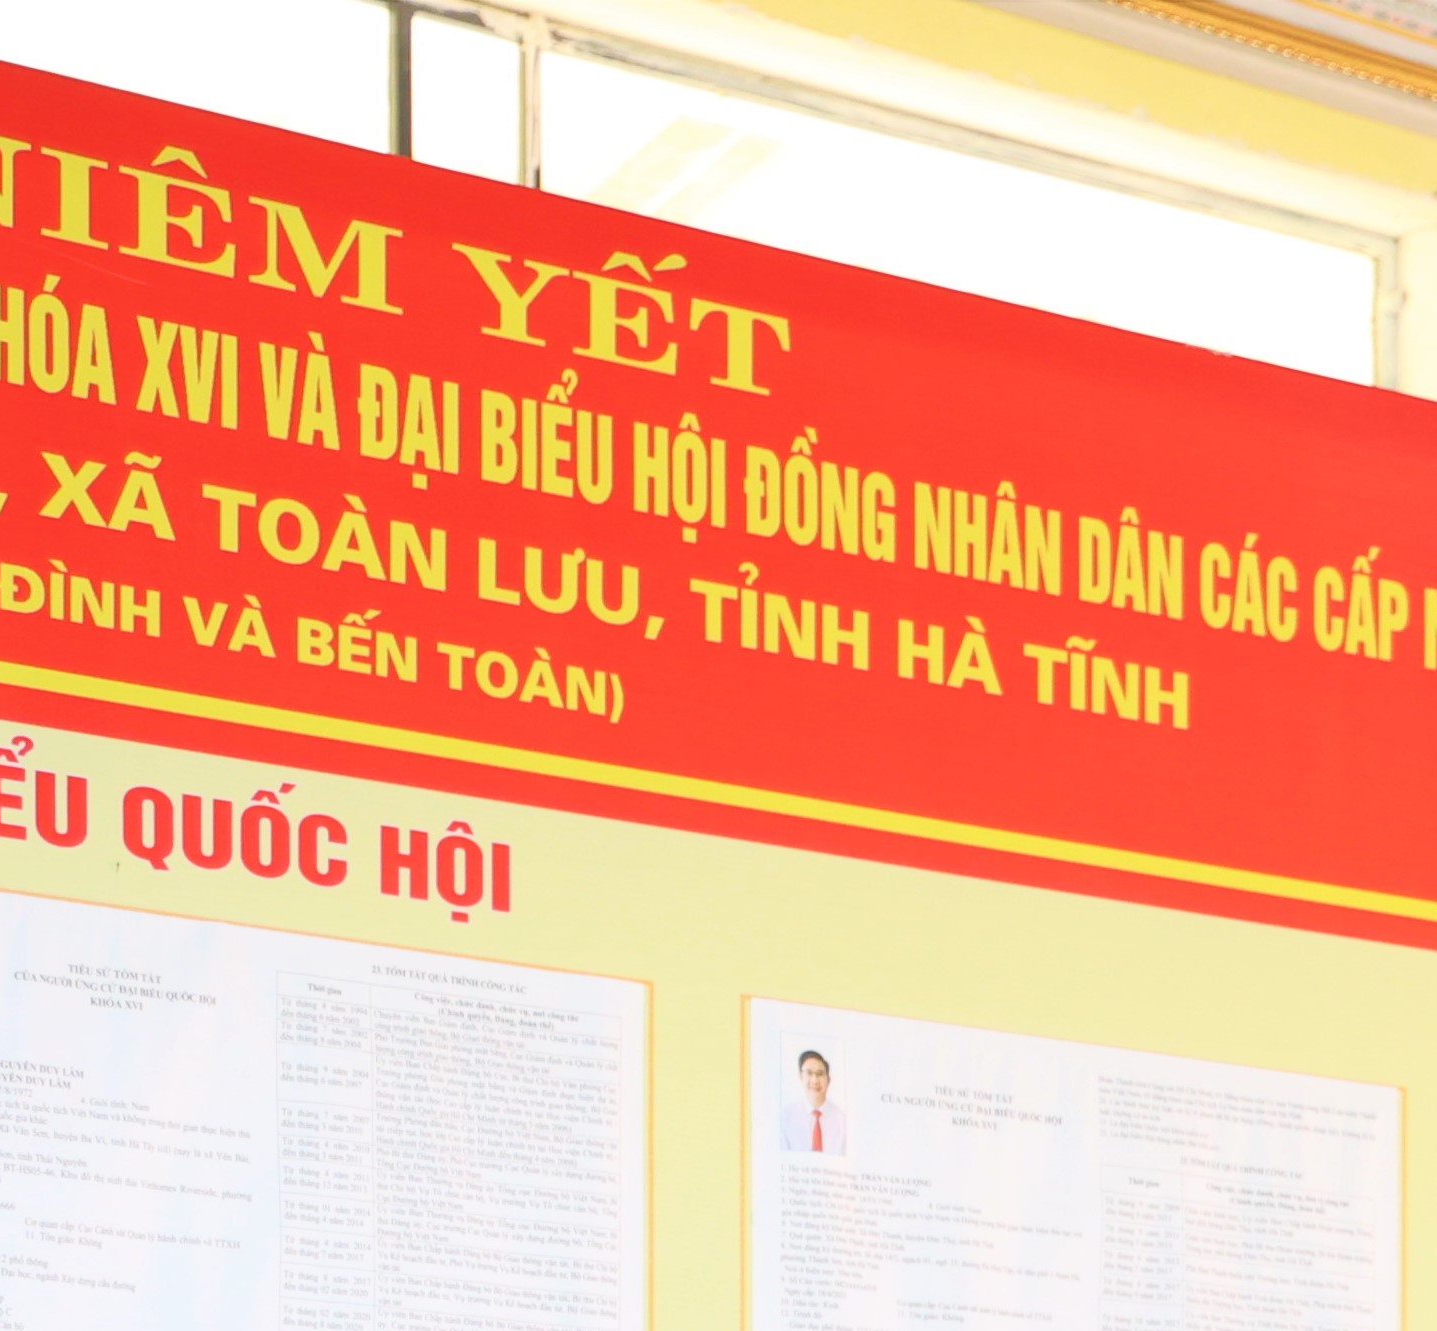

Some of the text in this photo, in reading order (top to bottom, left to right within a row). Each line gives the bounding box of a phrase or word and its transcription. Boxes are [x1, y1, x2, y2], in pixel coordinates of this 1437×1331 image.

[452, 243, 790, 395] YẾT
[136, 316, 238, 429] XVI
[259, 331, 340, 450] VÀ
[358, 364, 459, 489] ĐẠI
[481, 368, 613, 504] BIỂU
[634, 412, 726, 543] HỘI
[744, 427, 896, 562] ĐỒNG
[915, 481, 1062, 596] NHÂN
[1079, 506, 1183, 620] DÂN
[1200, 532, 1299, 642] CÁC
[1314, 546, 1410, 661] CẤP
[40, 452, 175, 540] XÃ
[202, 484, 446, 591] TOÀN
[478, 538, 664, 640] LƯU,
[690, 562, 869, 670] TỈNH
[898, 616, 1003, 695] HÀ
[1023, 636, 1189, 730] TĨNH
[183, 594, 275, 657] VÀ
[297, 609, 417, 682] BẾN
[437, 642, 624, 723] TOÀN)
[123, 784, 346, 886] QUỐC
[381, 821, 509, 922] HỘI
